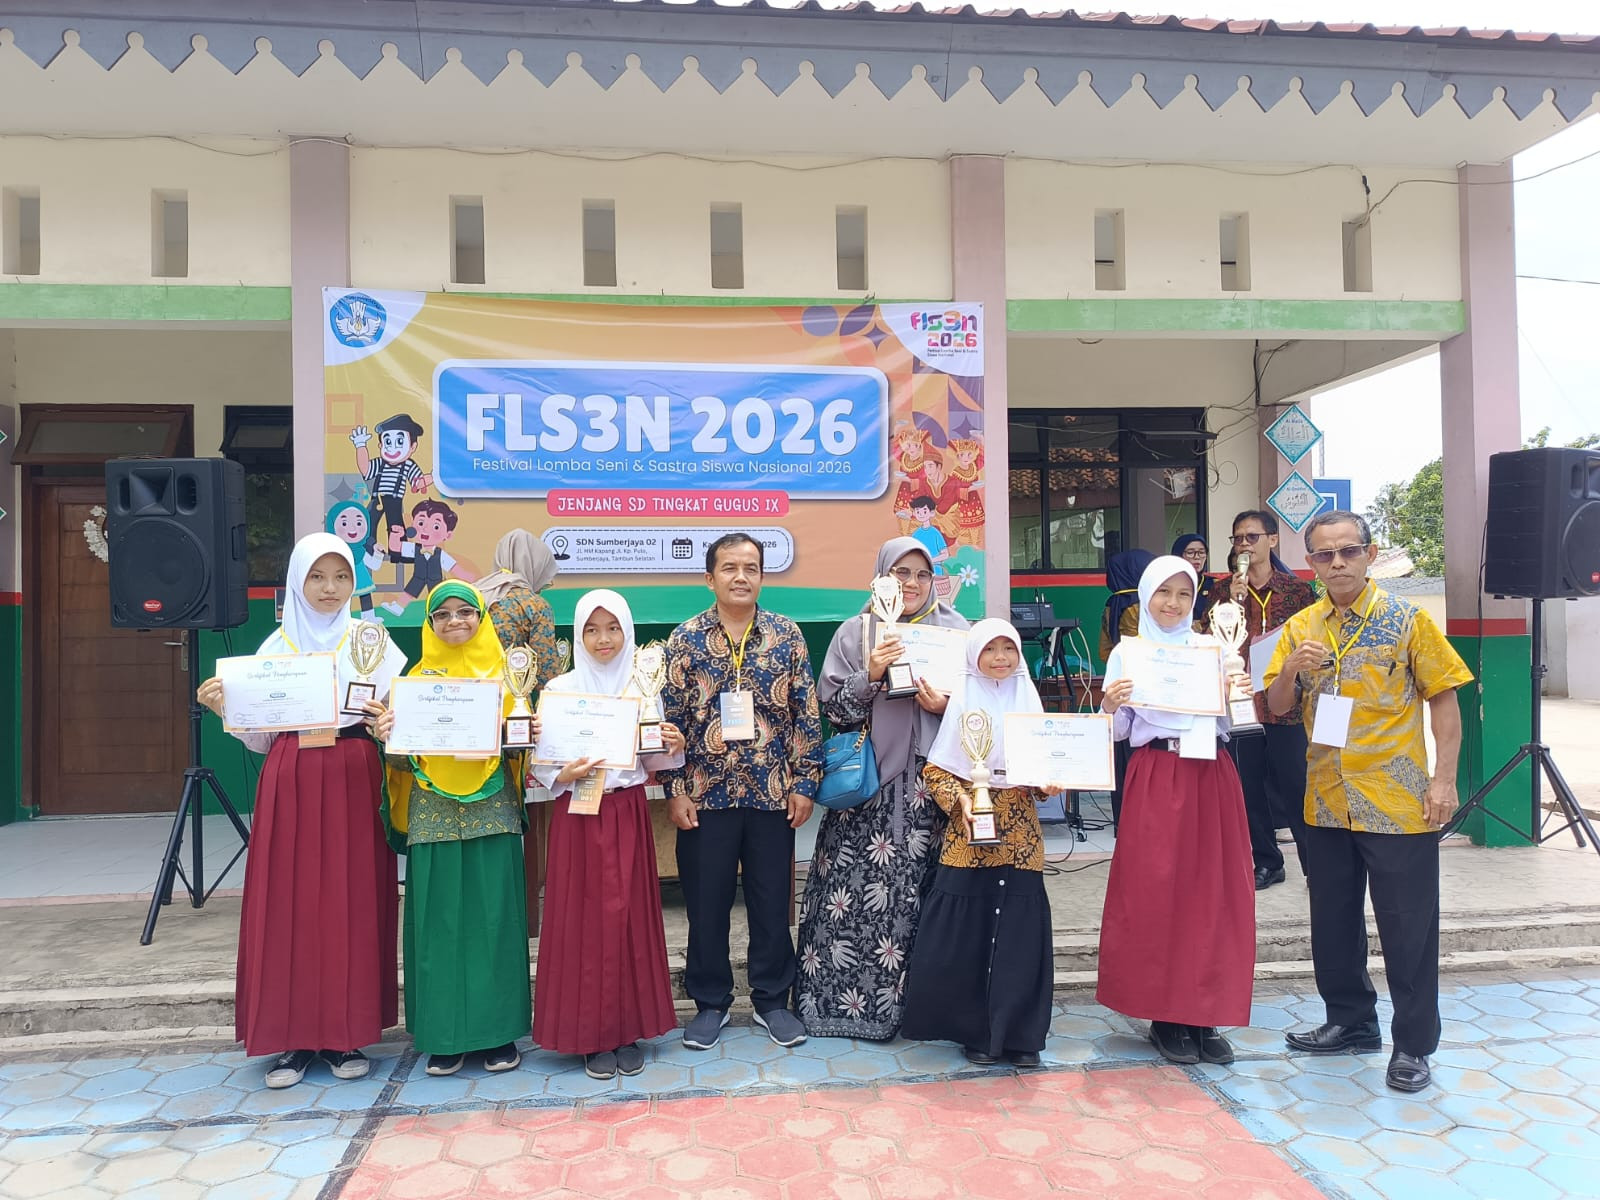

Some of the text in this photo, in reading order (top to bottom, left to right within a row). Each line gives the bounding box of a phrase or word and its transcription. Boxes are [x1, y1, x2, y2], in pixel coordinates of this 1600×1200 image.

[927, 332, 977, 347] 2026
[466, 393, 857, 456] FLS3N 2026
[473, 458, 851, 474] Festival Lomba Seni & Sastra Siswa Nasional 2026
[558, 497, 779, 512] JENJANG SD TINGKAT GUGUS IX
[596, 538, 644, 547] Sumberjaya
